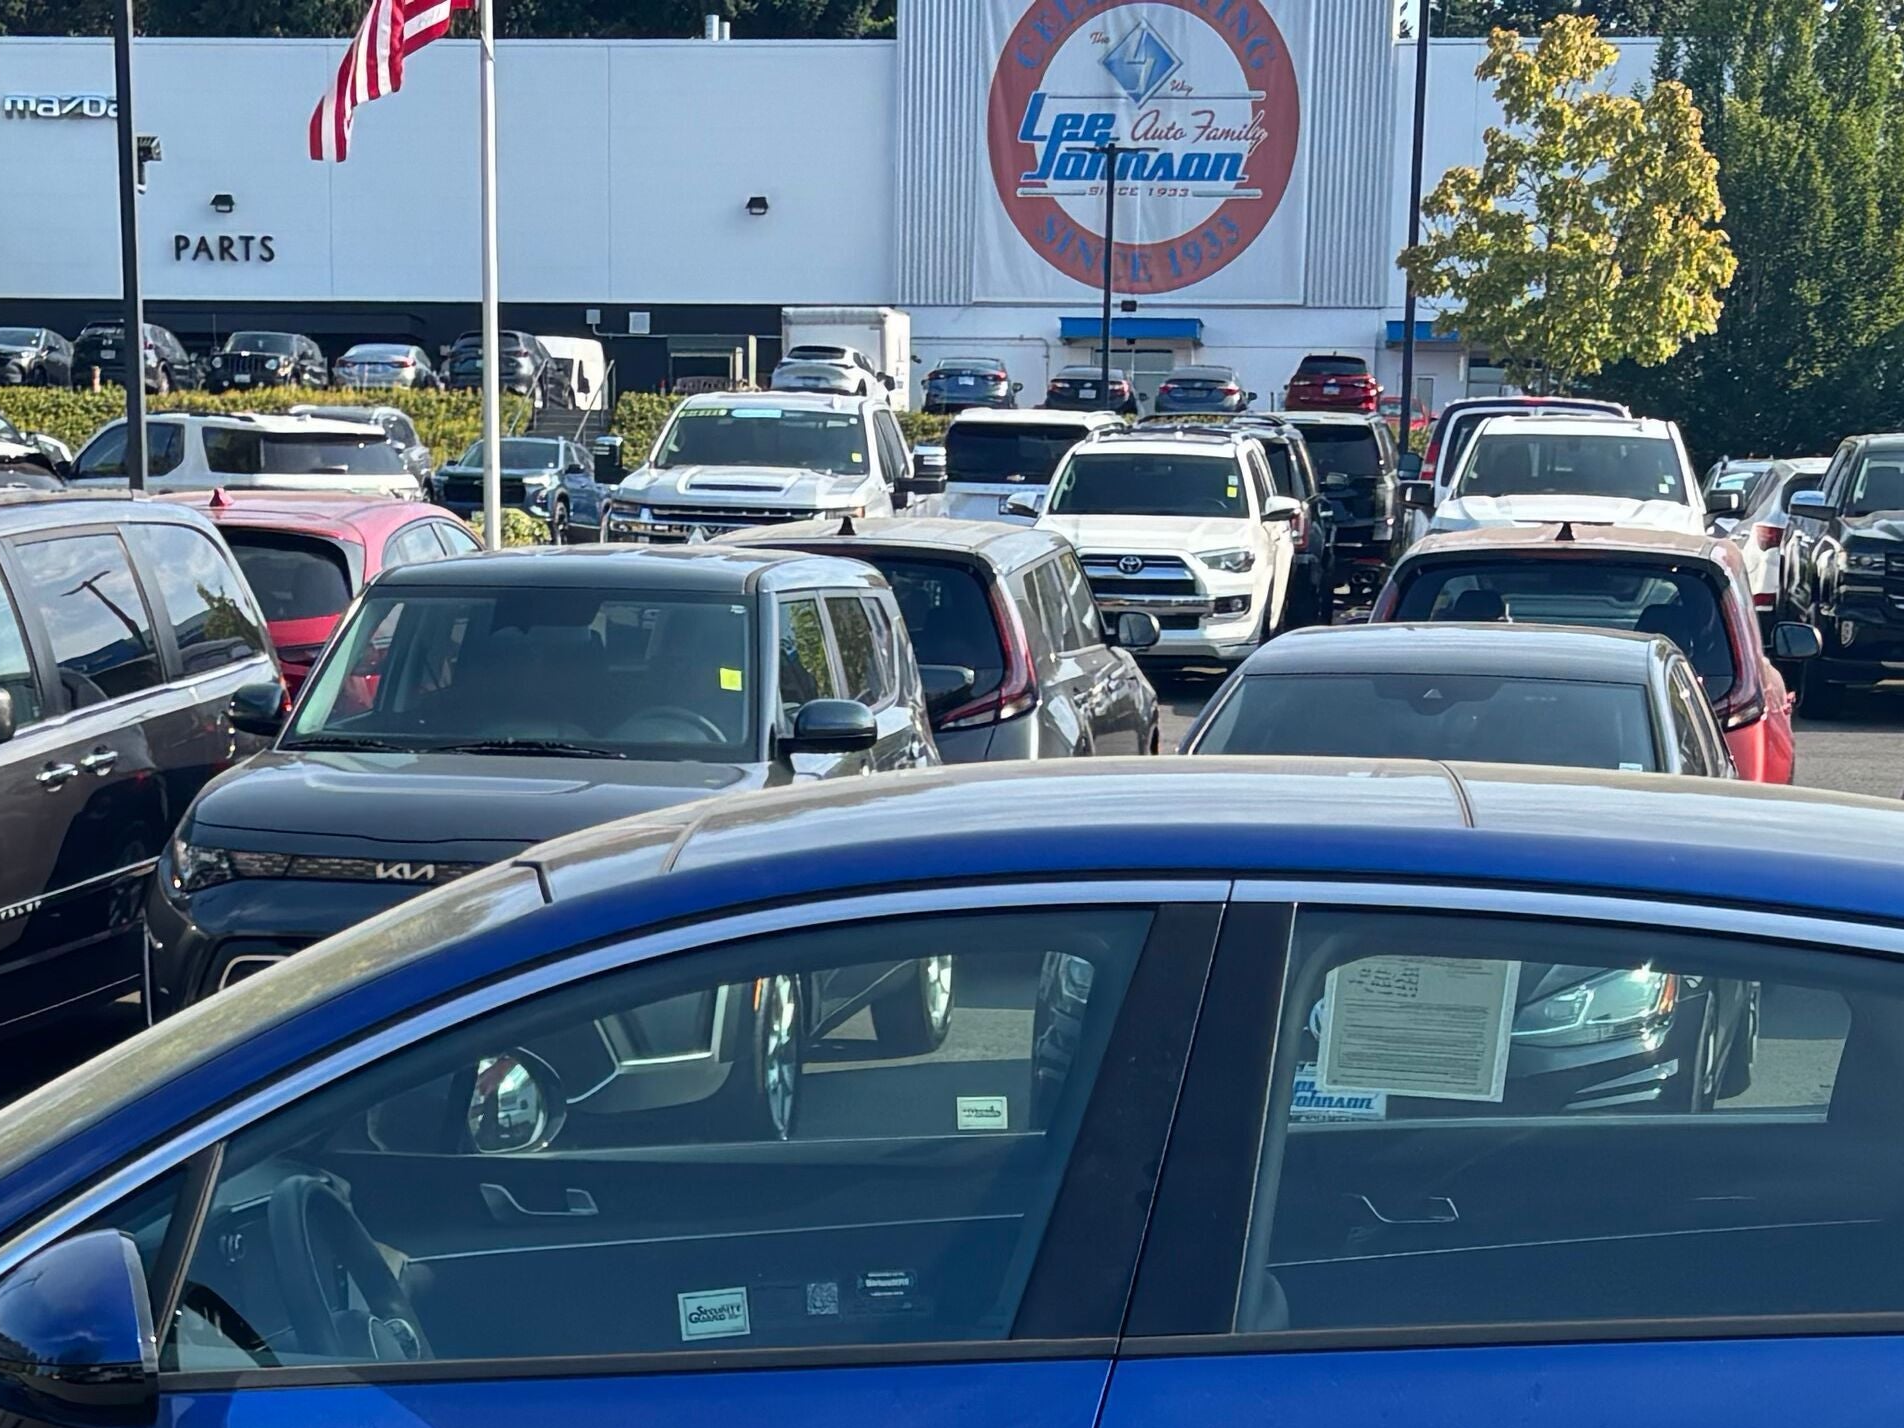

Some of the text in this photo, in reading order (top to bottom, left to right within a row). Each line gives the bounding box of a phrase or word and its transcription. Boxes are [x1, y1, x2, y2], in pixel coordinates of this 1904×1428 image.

[1014, 0, 1277, 69] CELING
[1089, 31, 1110, 45] The
[1169, 79, 1194, 96] Way
[1017, 92, 1269, 156] Lee Auto Family
[1088, 186, 1190, 198] SICE 1933
[174, 235, 275, 262] PARTS
[1167, 215, 1241, 279] 1933
[376, 862, 435, 880] KIA
[1295, 1092, 1375, 1110] ohnson
